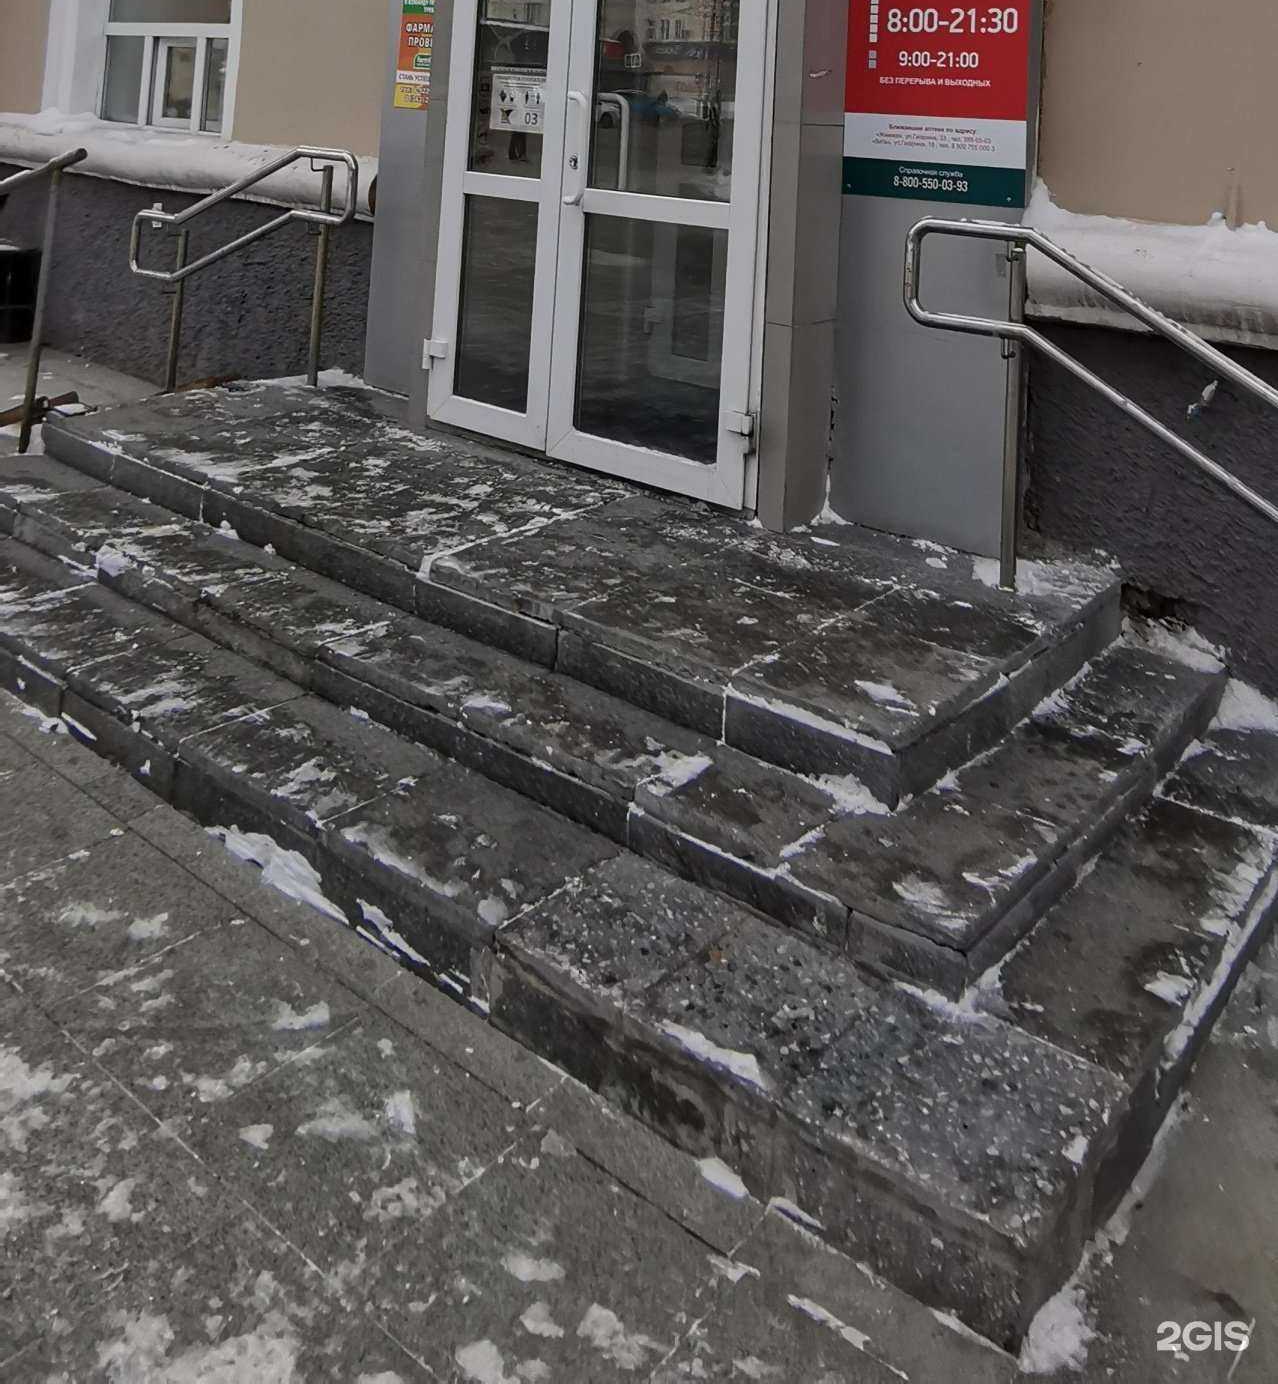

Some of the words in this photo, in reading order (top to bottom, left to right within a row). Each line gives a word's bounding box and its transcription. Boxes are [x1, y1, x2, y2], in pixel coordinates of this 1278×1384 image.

[887, 7, 1018, 34] 8:00-21:30
[898, 51, 979, 68] 9:00-21:00
[895, 77, 936, 86] ПЕРЕРЫВА
[944, 79, 991, 88] ВЫХОДНЫХ
[893, 175, 968, 192] 8-800-550-03-93
